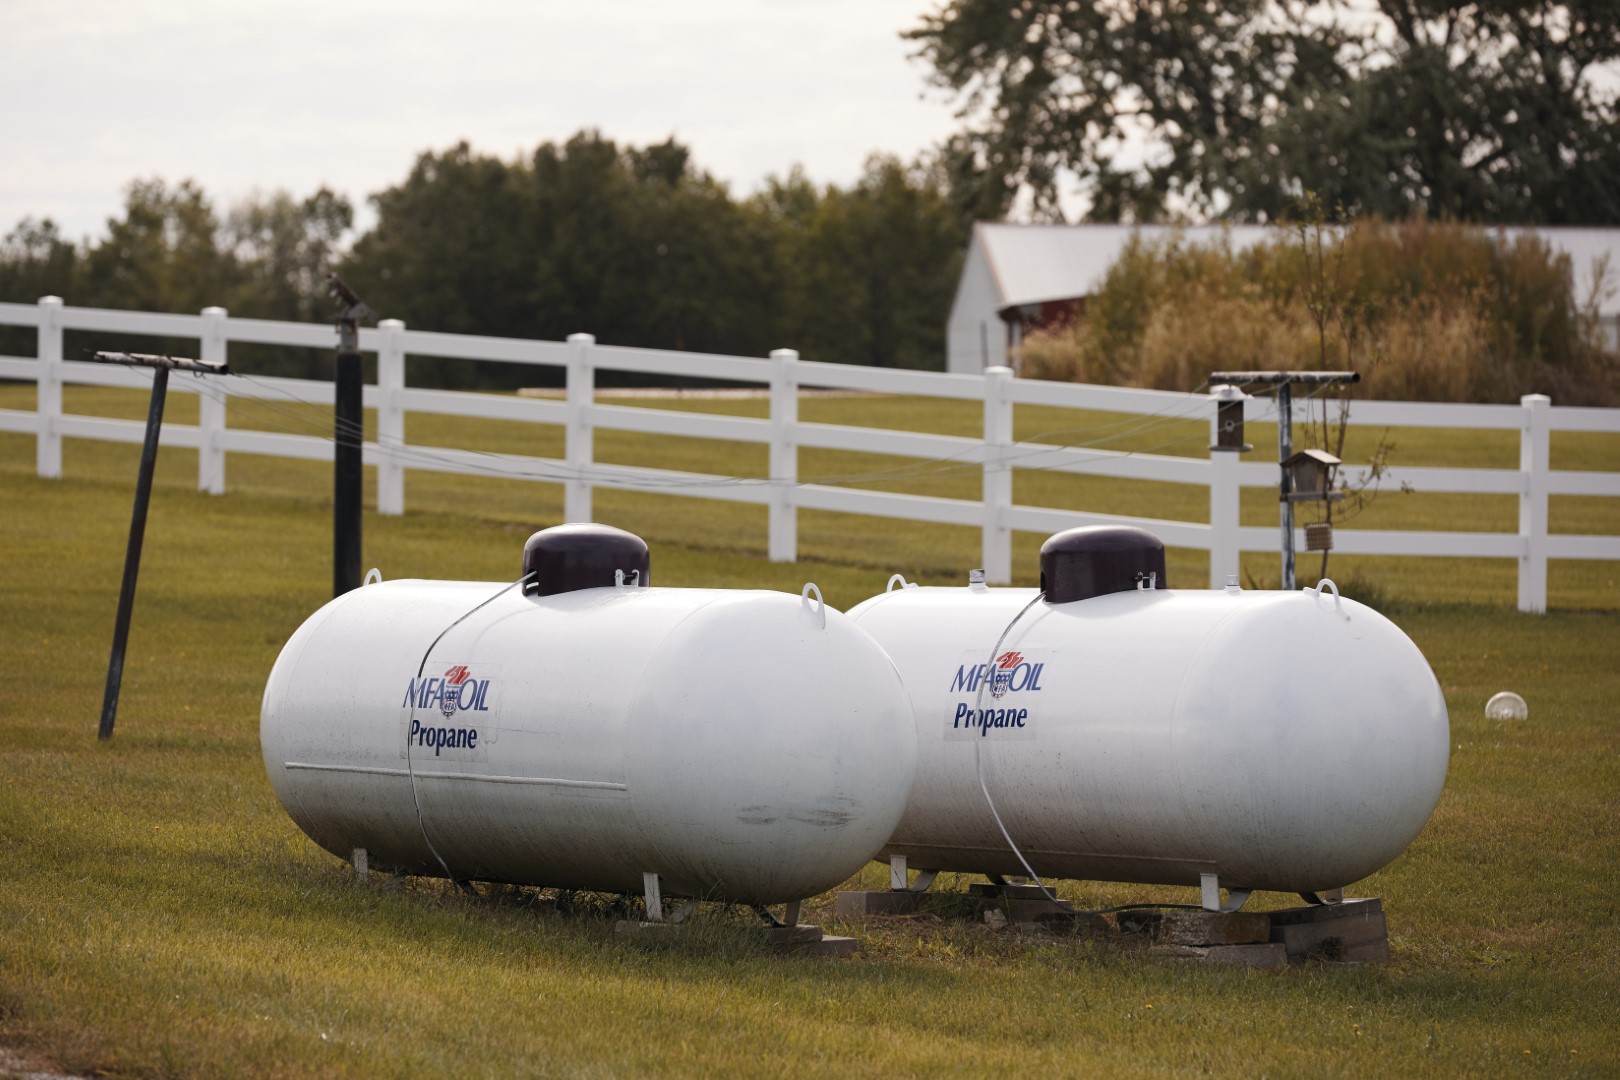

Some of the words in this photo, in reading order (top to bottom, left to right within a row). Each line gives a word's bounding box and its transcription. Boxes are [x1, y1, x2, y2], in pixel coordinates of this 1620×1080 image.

[950, 664, 997, 692] MFA
[1008, 663, 1044, 691] OIL
[403, 678, 446, 709] MFA
[457, 679, 490, 711] OIL
[954, 703, 1028, 737] Propane
[410, 720, 478, 756] Propane
